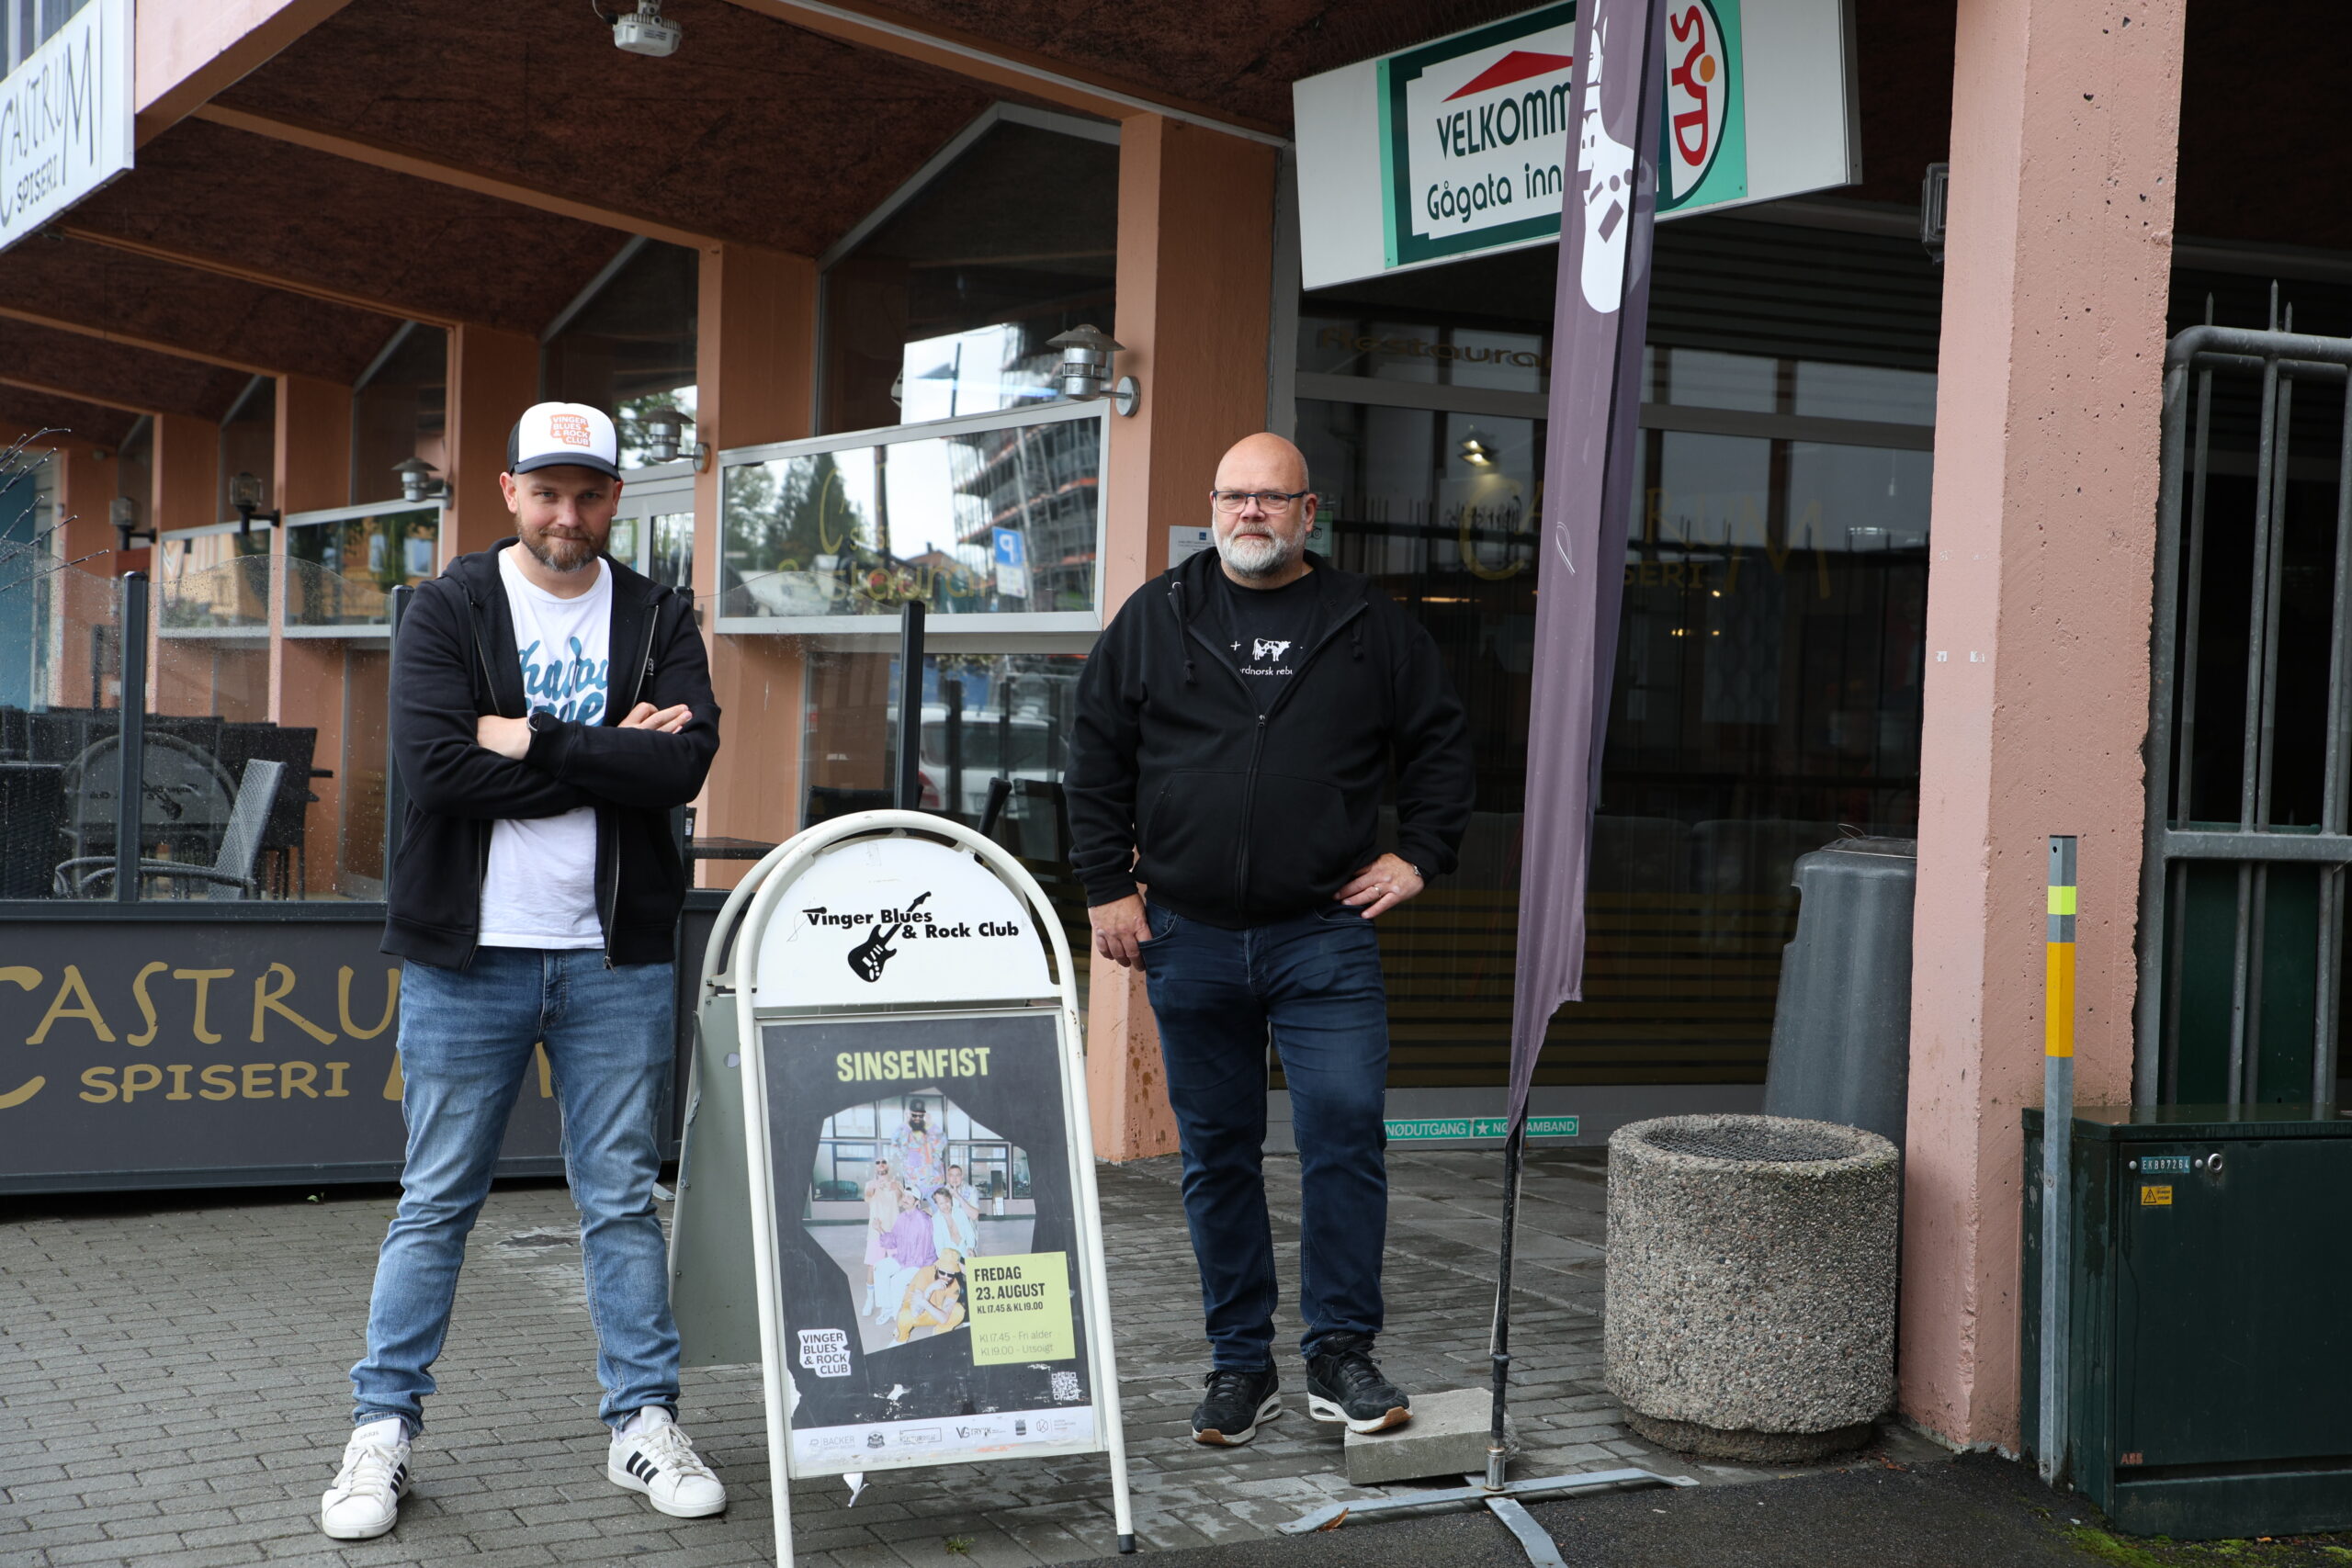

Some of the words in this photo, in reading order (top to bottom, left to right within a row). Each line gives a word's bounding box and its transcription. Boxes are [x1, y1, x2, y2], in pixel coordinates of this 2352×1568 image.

[1436, 81, 1571, 160] VELKOMM
[17, 153, 58, 214] SPISERI
[1427, 173, 1512, 223] Gågata
[1524, 162, 1563, 199] inn
[1320, 325, 1555, 368] Restaura
[553, 415, 587, 425] VINGER
[553, 423, 581, 431] BLUES
[563, 430, 588, 438] ROCK
[565, 436, 589, 446] CLUB
[1240, 664, 1273, 676] rdnorsk
[807, 913, 874, 930] Vinger
[880, 908, 933, 923] Blues
[901, 924, 918, 939] &
[925, 922, 971, 938] Rock
[978, 921, 1019, 937] Club
[837, 1047, 990, 1082] SINSENFIST
[79, 1060, 351, 1103] SPISERI
[1385, 1122, 1466, 1137] NØDUTGANG
[974, 1266, 1022, 1282] FREDAG
[976, 1286, 995, 1301] 23.
[998, 1282, 1046, 1299] AUGUST
[977, 1305, 987, 1314] KL
[987, 1303, 1005, 1314] 17.45
[1006, 1303, 1012, 1312] &
[1013, 1303, 1023, 1312] KL
[1023, 1301, 1044, 1311] 19.00
[802, 1332, 843, 1344] VINGER
[803, 1343, 838, 1355] BLUES
[804, 1355, 814, 1365] &
[816, 1353, 847, 1364] ROCK
[820, 1364, 848, 1374] CLUB
[823, 1436, 854, 1446] BACKER
